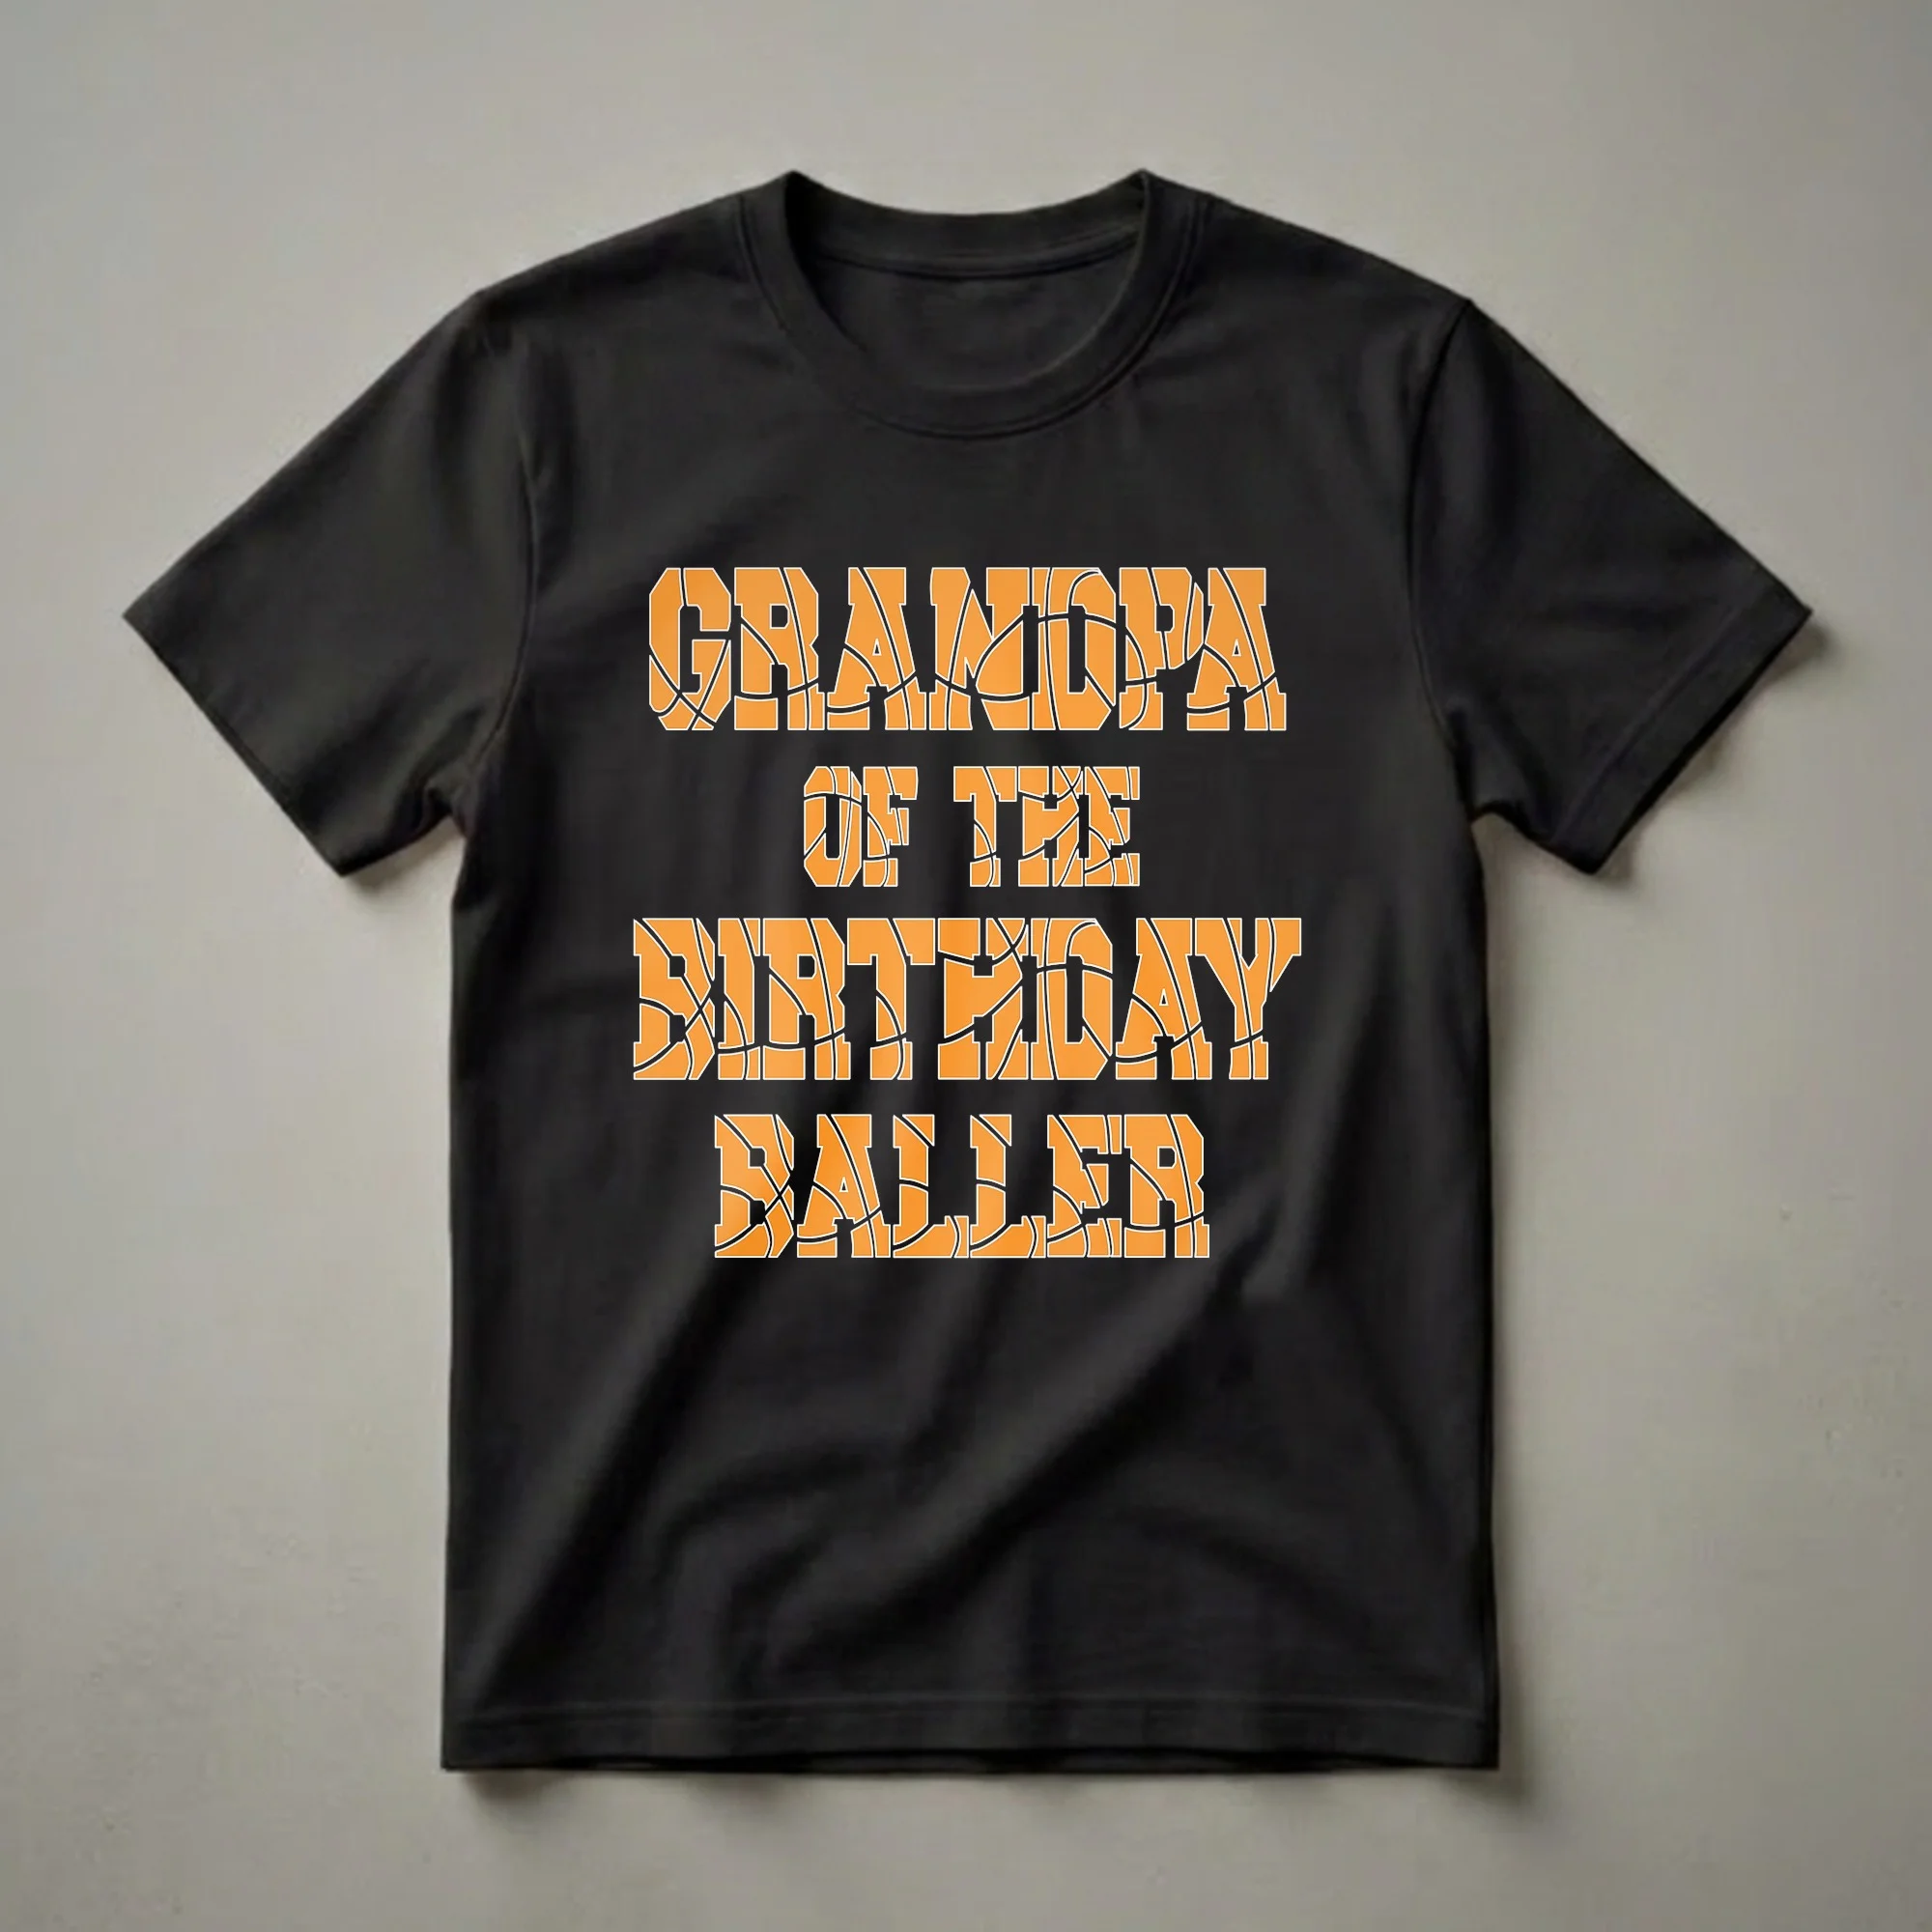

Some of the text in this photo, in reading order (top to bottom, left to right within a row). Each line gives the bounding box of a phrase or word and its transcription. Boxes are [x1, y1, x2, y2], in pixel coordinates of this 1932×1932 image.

[648, 566, 1287, 731] GRANDPA
[803, 765, 1141, 888] OF THE
[633, 917, 1302, 1081] BIRTHDAY
[714, 1113, 1210, 1259] BALLER
